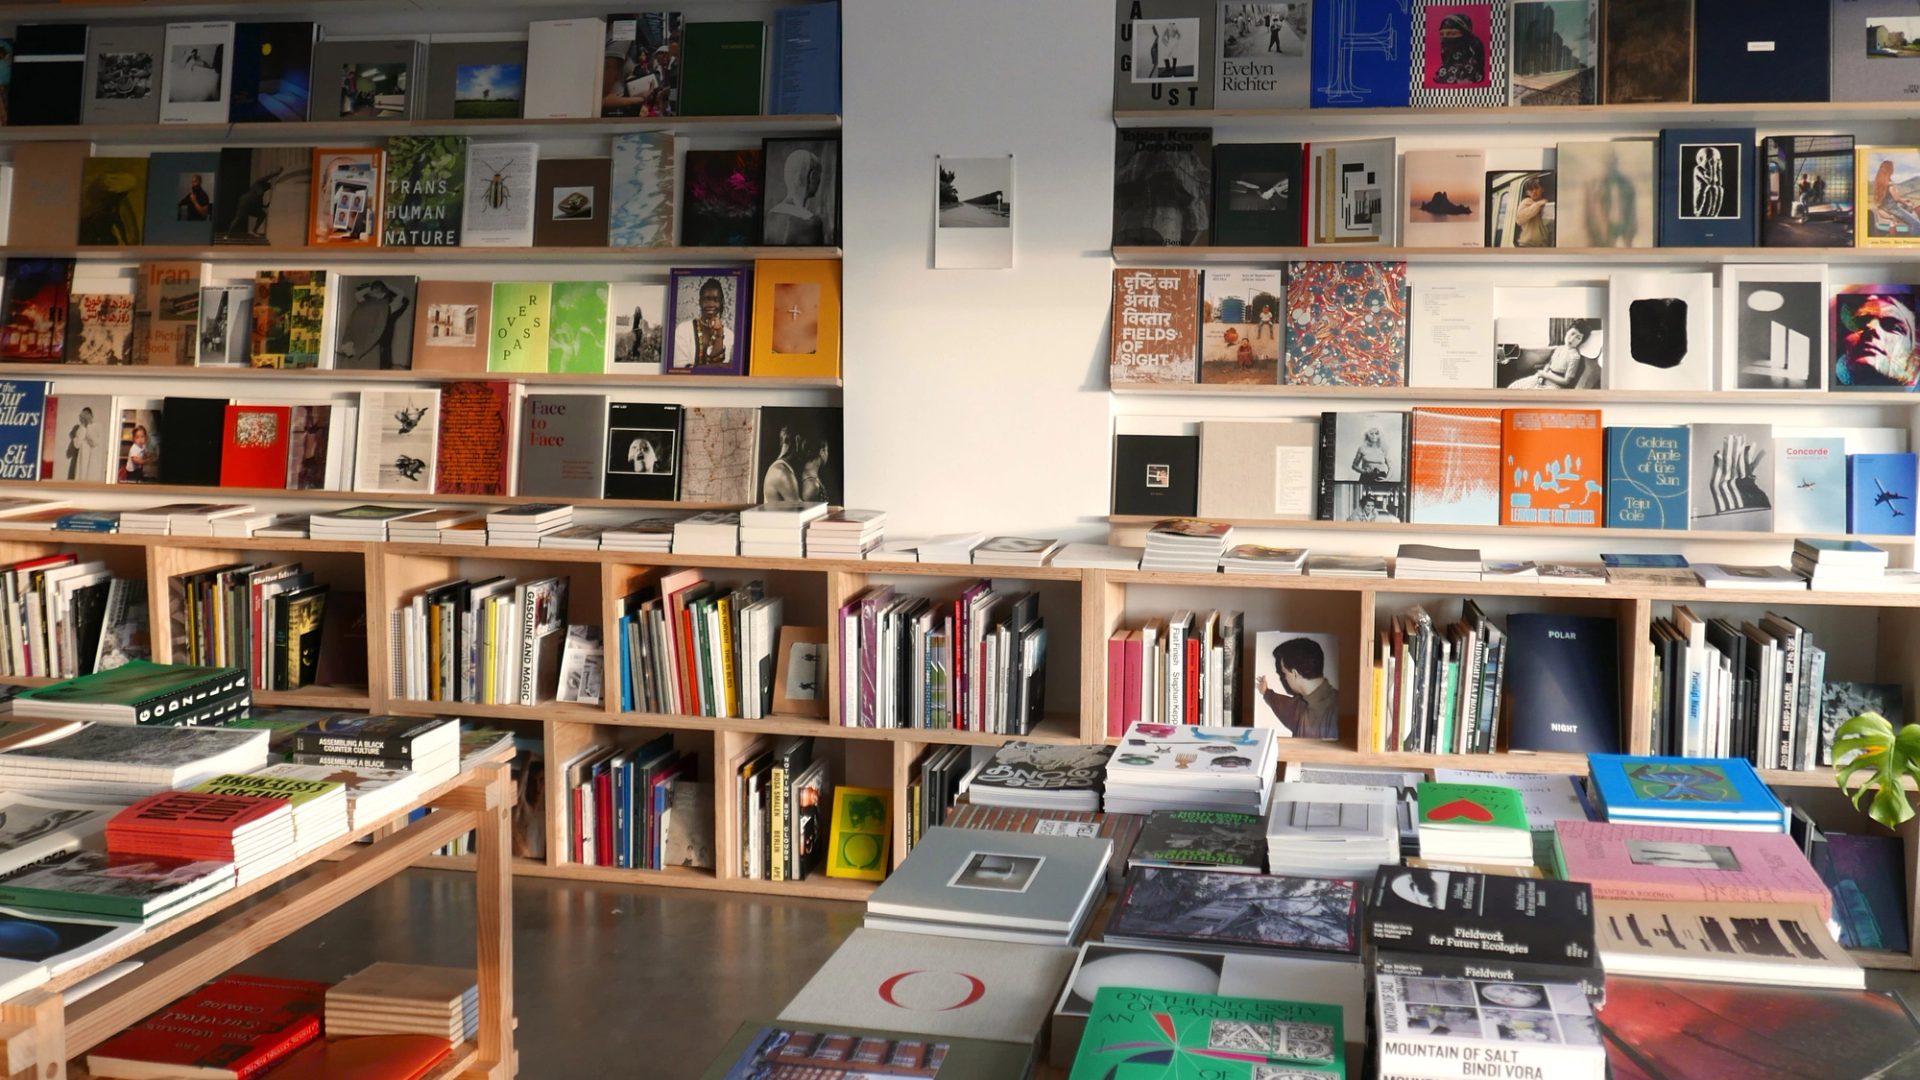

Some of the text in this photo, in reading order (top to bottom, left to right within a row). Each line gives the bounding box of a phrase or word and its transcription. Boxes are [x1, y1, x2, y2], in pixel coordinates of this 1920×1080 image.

[1223, 61, 1273, 77] Evelyn
[1222, 77, 1277, 91] Richter
[1167, 130, 1210, 141] Kruse
[388, 180, 447, 194] TRANS
[386, 205, 445, 220] HUMAN
[384, 230, 455, 245] NATURE
[151, 264, 191, 285] Iran
[1158, 277, 1181, 290] का
[1122, 328, 1176, 341] FIELDS
[1121, 341, 1143, 352] OF
[1120, 353, 1169, 366] SIGHT
[3, 382, 16, 393] the
[0, 392, 26, 406] our
[532, 400, 566, 416] Face
[0, 406, 39, 426] illars
[531, 418, 547, 430] to
[530, 432, 564, 447] Face
[1635, 436, 1677, 449] Golden
[4, 444, 28, 464] Eli
[1647, 448, 1681, 463] Apple
[1786, 448, 1829, 456] Concorde
[1638, 461, 1675, 473] of the
[1656, 473, 1680, 486] Sun
[1624, 496, 1650, 511] Teju
[1619, 509, 1645, 521] Cole
[1548, 630, 1577, 639] POLAR
[521, 591, 535, 701] GASOLINE AND MAGIC
[1473, 640, 1483, 679] MIDNIGHT
[1171, 628, 1180, 725] Flat Finish Stephan Kepp
[139, 677, 246, 722] GODZILLA
[1468, 694, 1478, 733] FRONTERA
[1551, 722, 1578, 733] NIGHT
[318, 738, 357, 747] ASSEMBLING
[364, 741, 384, 749] BLACK
[323, 745, 380, 755] COUNTER CULTURE
[318, 757, 358, 767] ASSEMBLING
[364, 760, 384, 768] BLACK
[773, 791, 781, 817] SMALEN
[1637, 890, 1675, 899] WOODMAN
[1455, 928, 1504, 942] Fieldwork
[1429, 935, 1529, 955] for Future Ecologies
[1464, 967, 1514, 980] Fieldwork
[1116, 991, 1154, 1002] ON
[1209, 998, 1321, 1017] NECESSITY
[1099, 1013, 1135, 1024] AN
[1166, 1004, 1307, 1024] GARDENING
[1385, 1042, 1518, 1063] MOUNTAIN OF SALT
[1463, 1061, 1543, 1080] BINDI VORA
